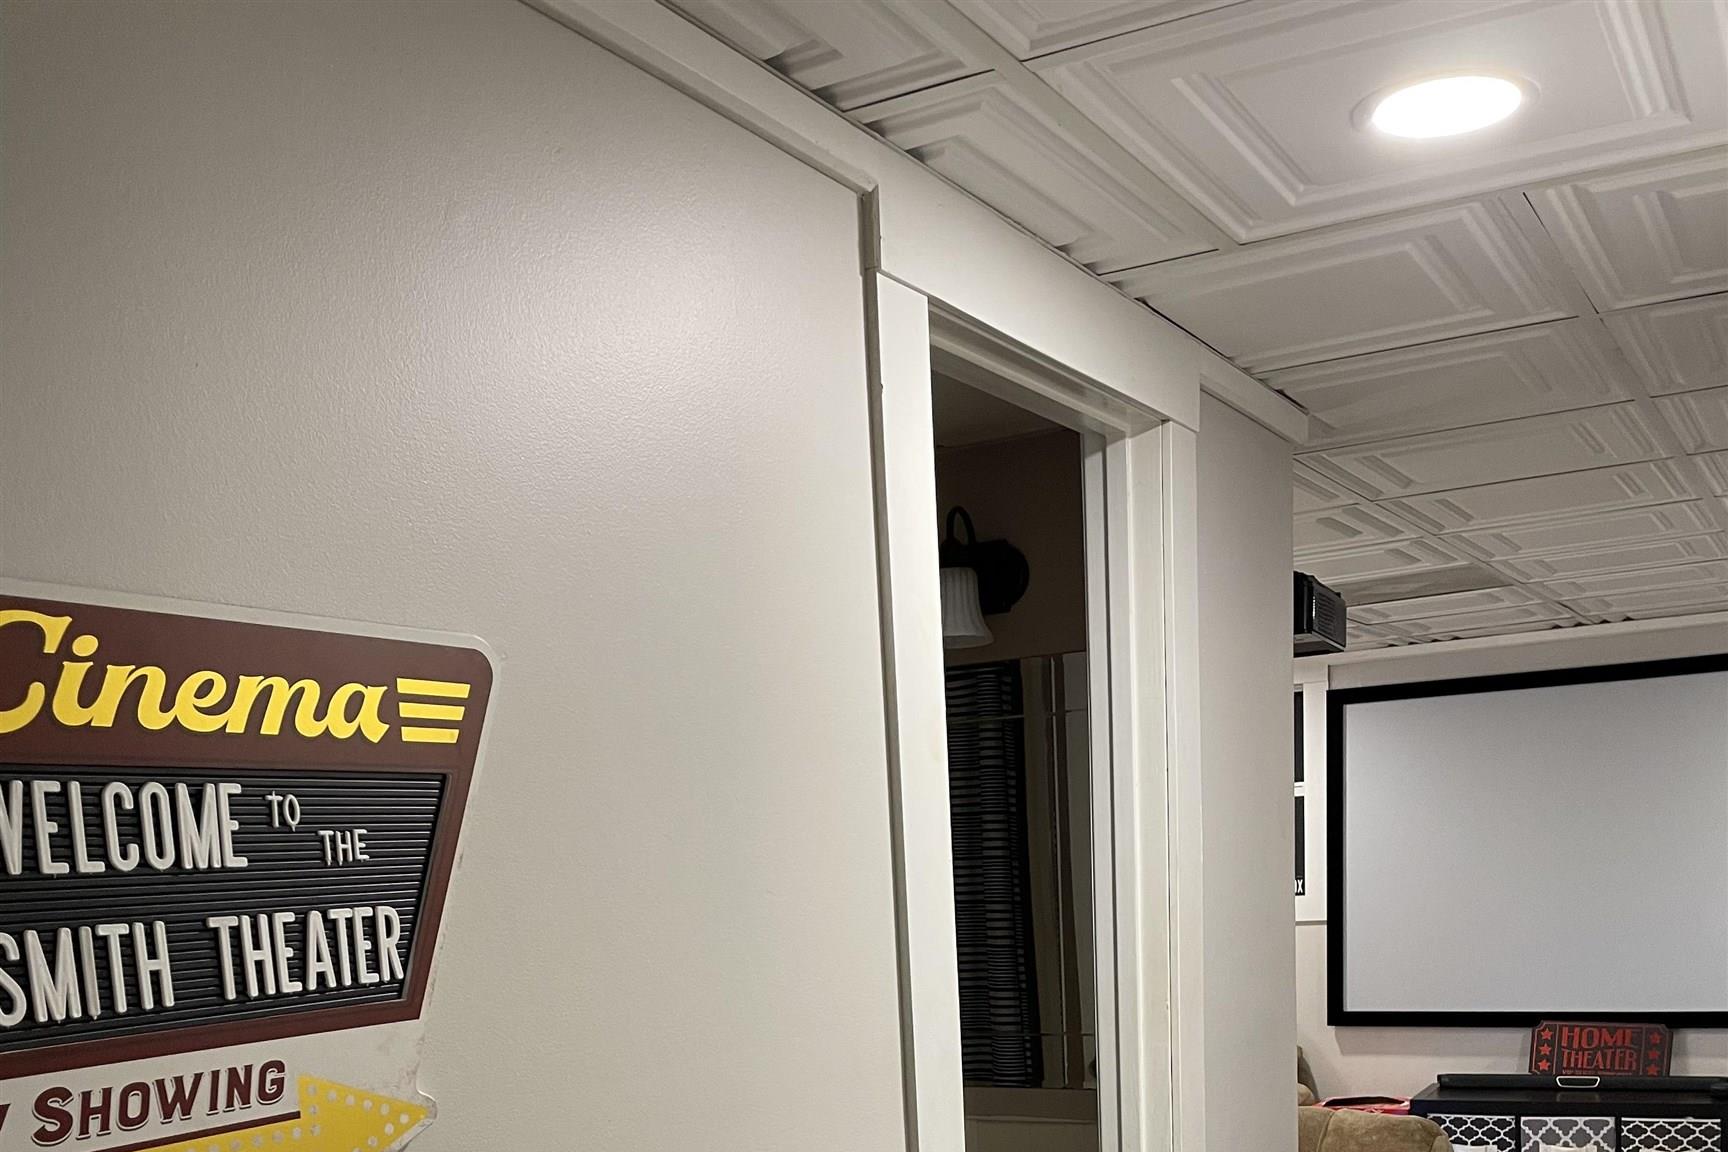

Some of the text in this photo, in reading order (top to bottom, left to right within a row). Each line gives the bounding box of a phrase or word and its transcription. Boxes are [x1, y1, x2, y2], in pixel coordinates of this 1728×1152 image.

[0, 609, 390, 743] Cinema
[265, 791, 301, 831] TO
[318, 829, 370, 866] THE
[0, 906, 404, 1027] SMITH THEATER
[1561, 1026, 1643, 1048] HOME
[1562, 1049, 1638, 1070] THEATER
[31, 1059, 286, 1147] SHOWING
